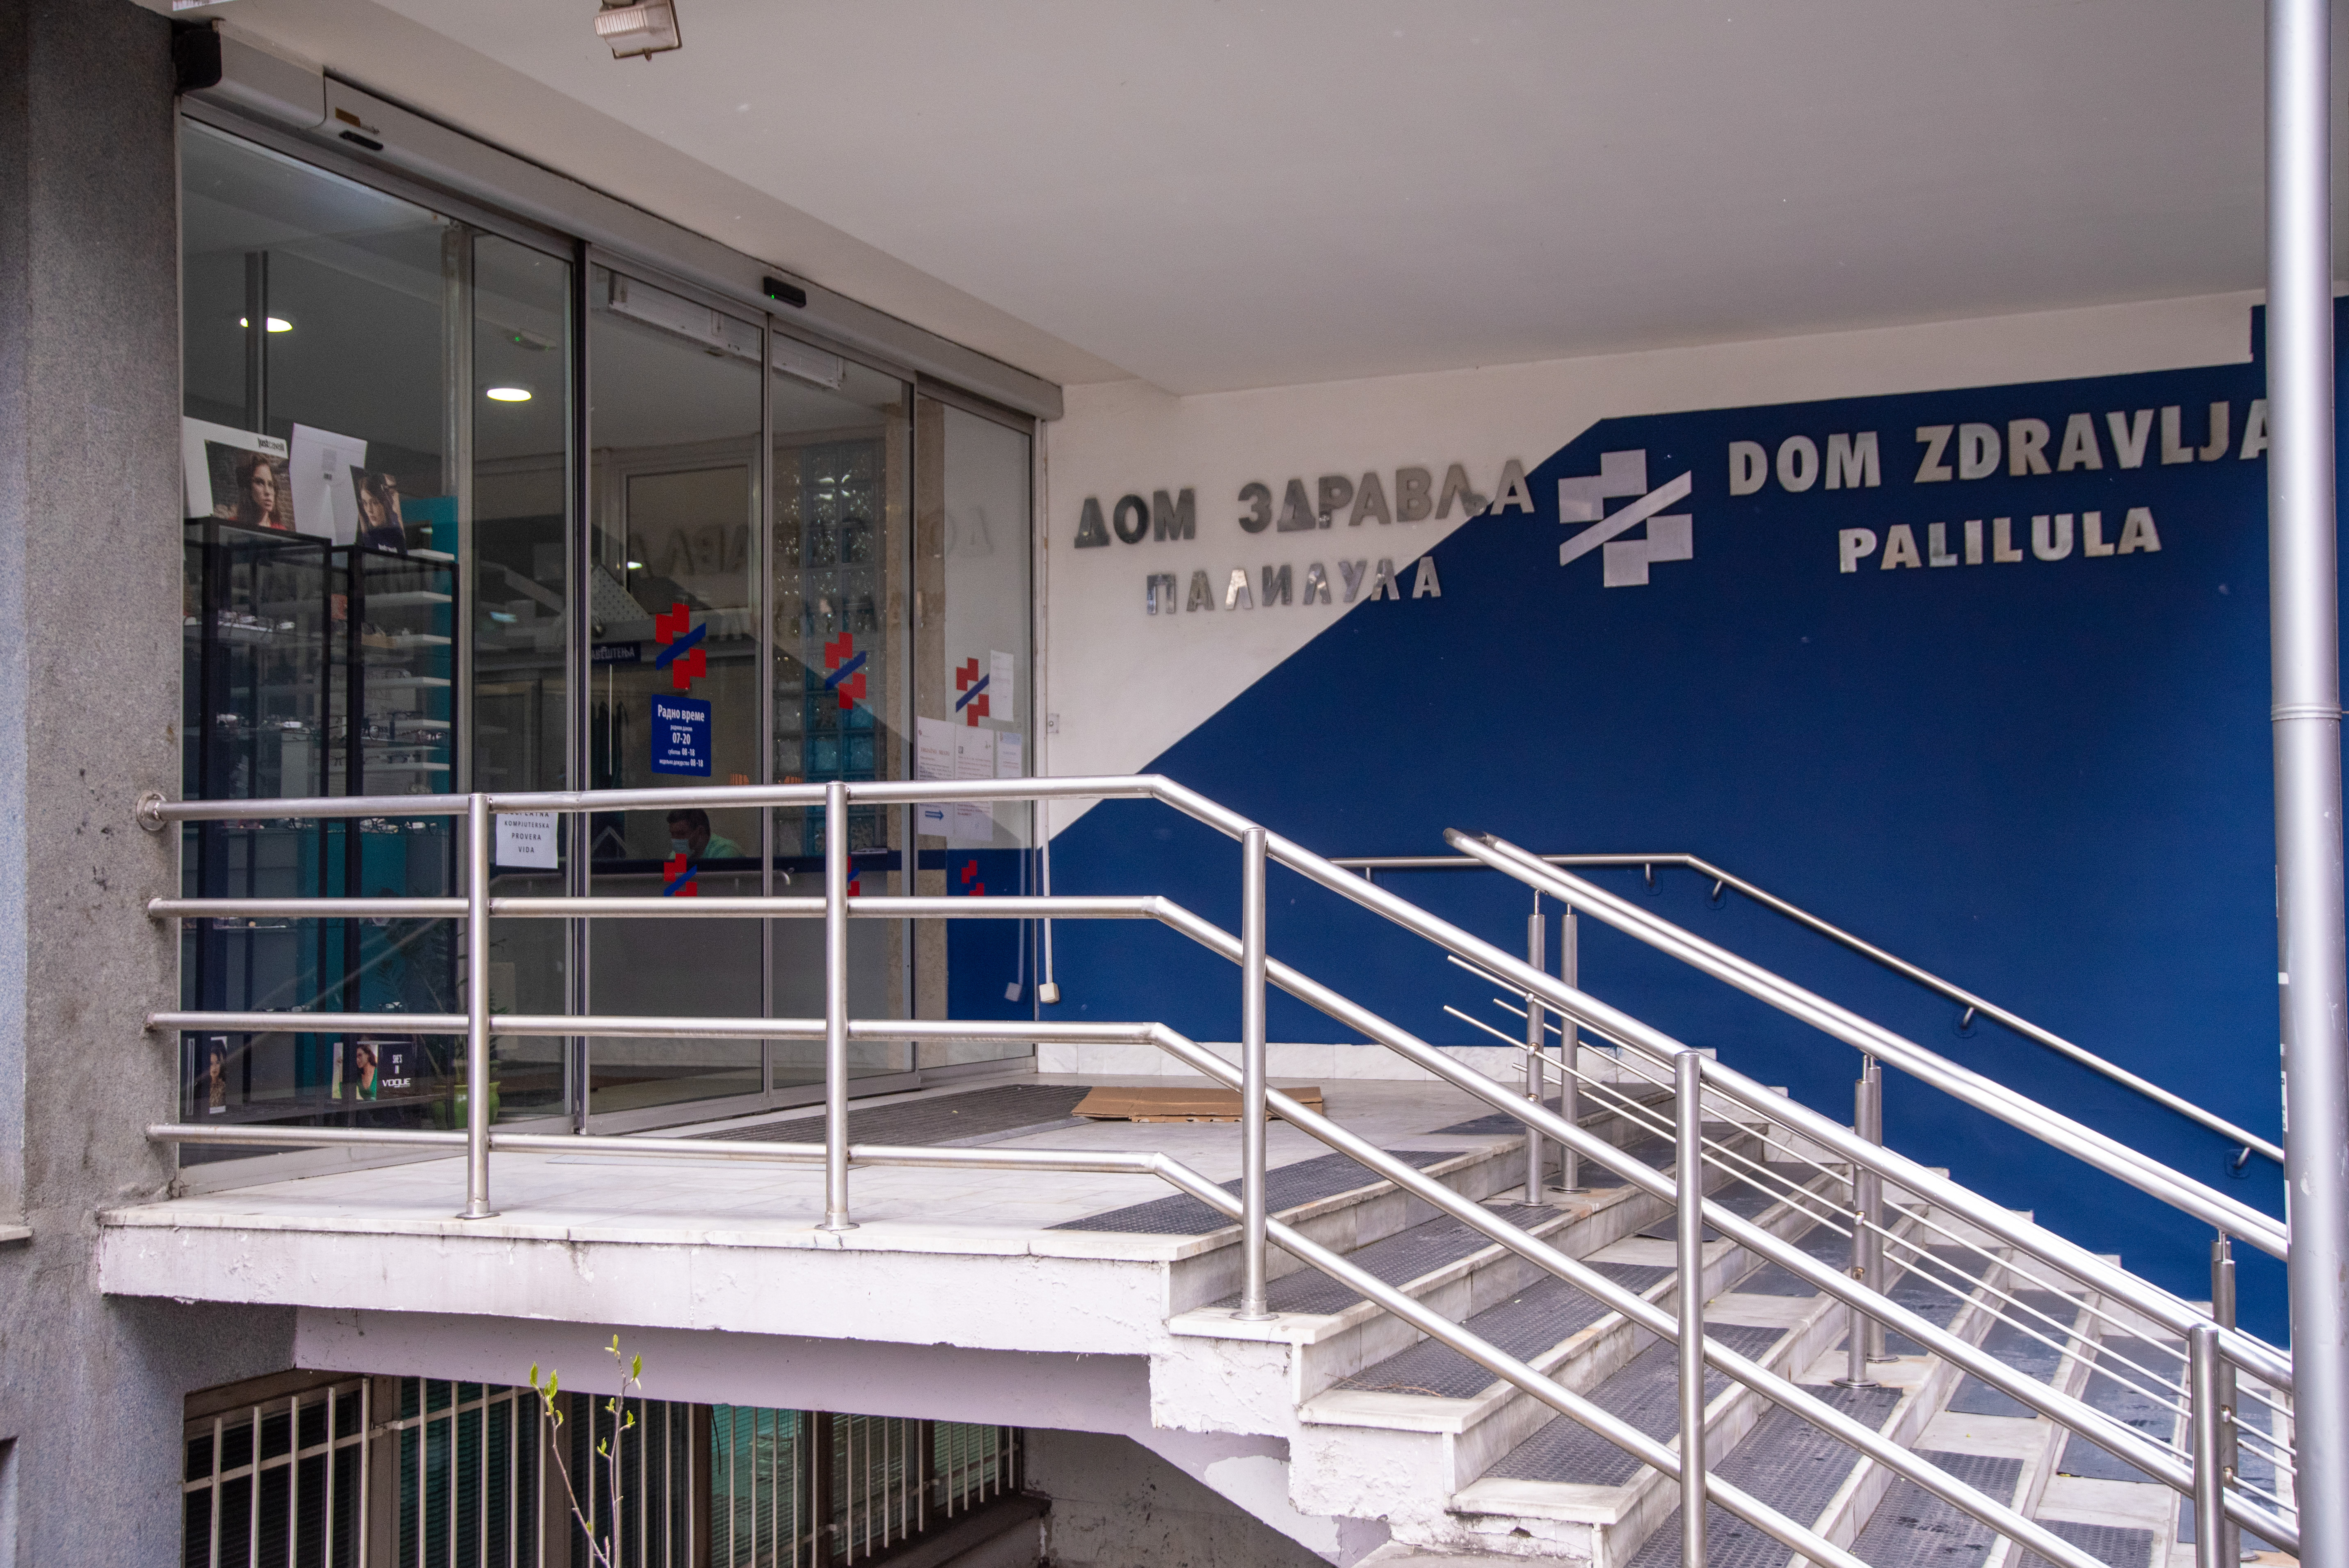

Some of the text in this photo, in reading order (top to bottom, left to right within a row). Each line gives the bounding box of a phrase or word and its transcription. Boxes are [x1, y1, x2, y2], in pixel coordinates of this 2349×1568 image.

[1729, 399, 2268, 496] DOM ZDRAVLJA
[1074, 459, 1535, 549] ДОМ ЗДРАВЉА
[1839, 507, 2162, 574] PALILULA
[1147, 556, 1442, 615] ПАЛИЛУЛА
[658, 704, 705, 723] Радно време
[672, 732, 691, 745] 07-20
[505, 820, 549, 828] KOMPJUTERSKA
